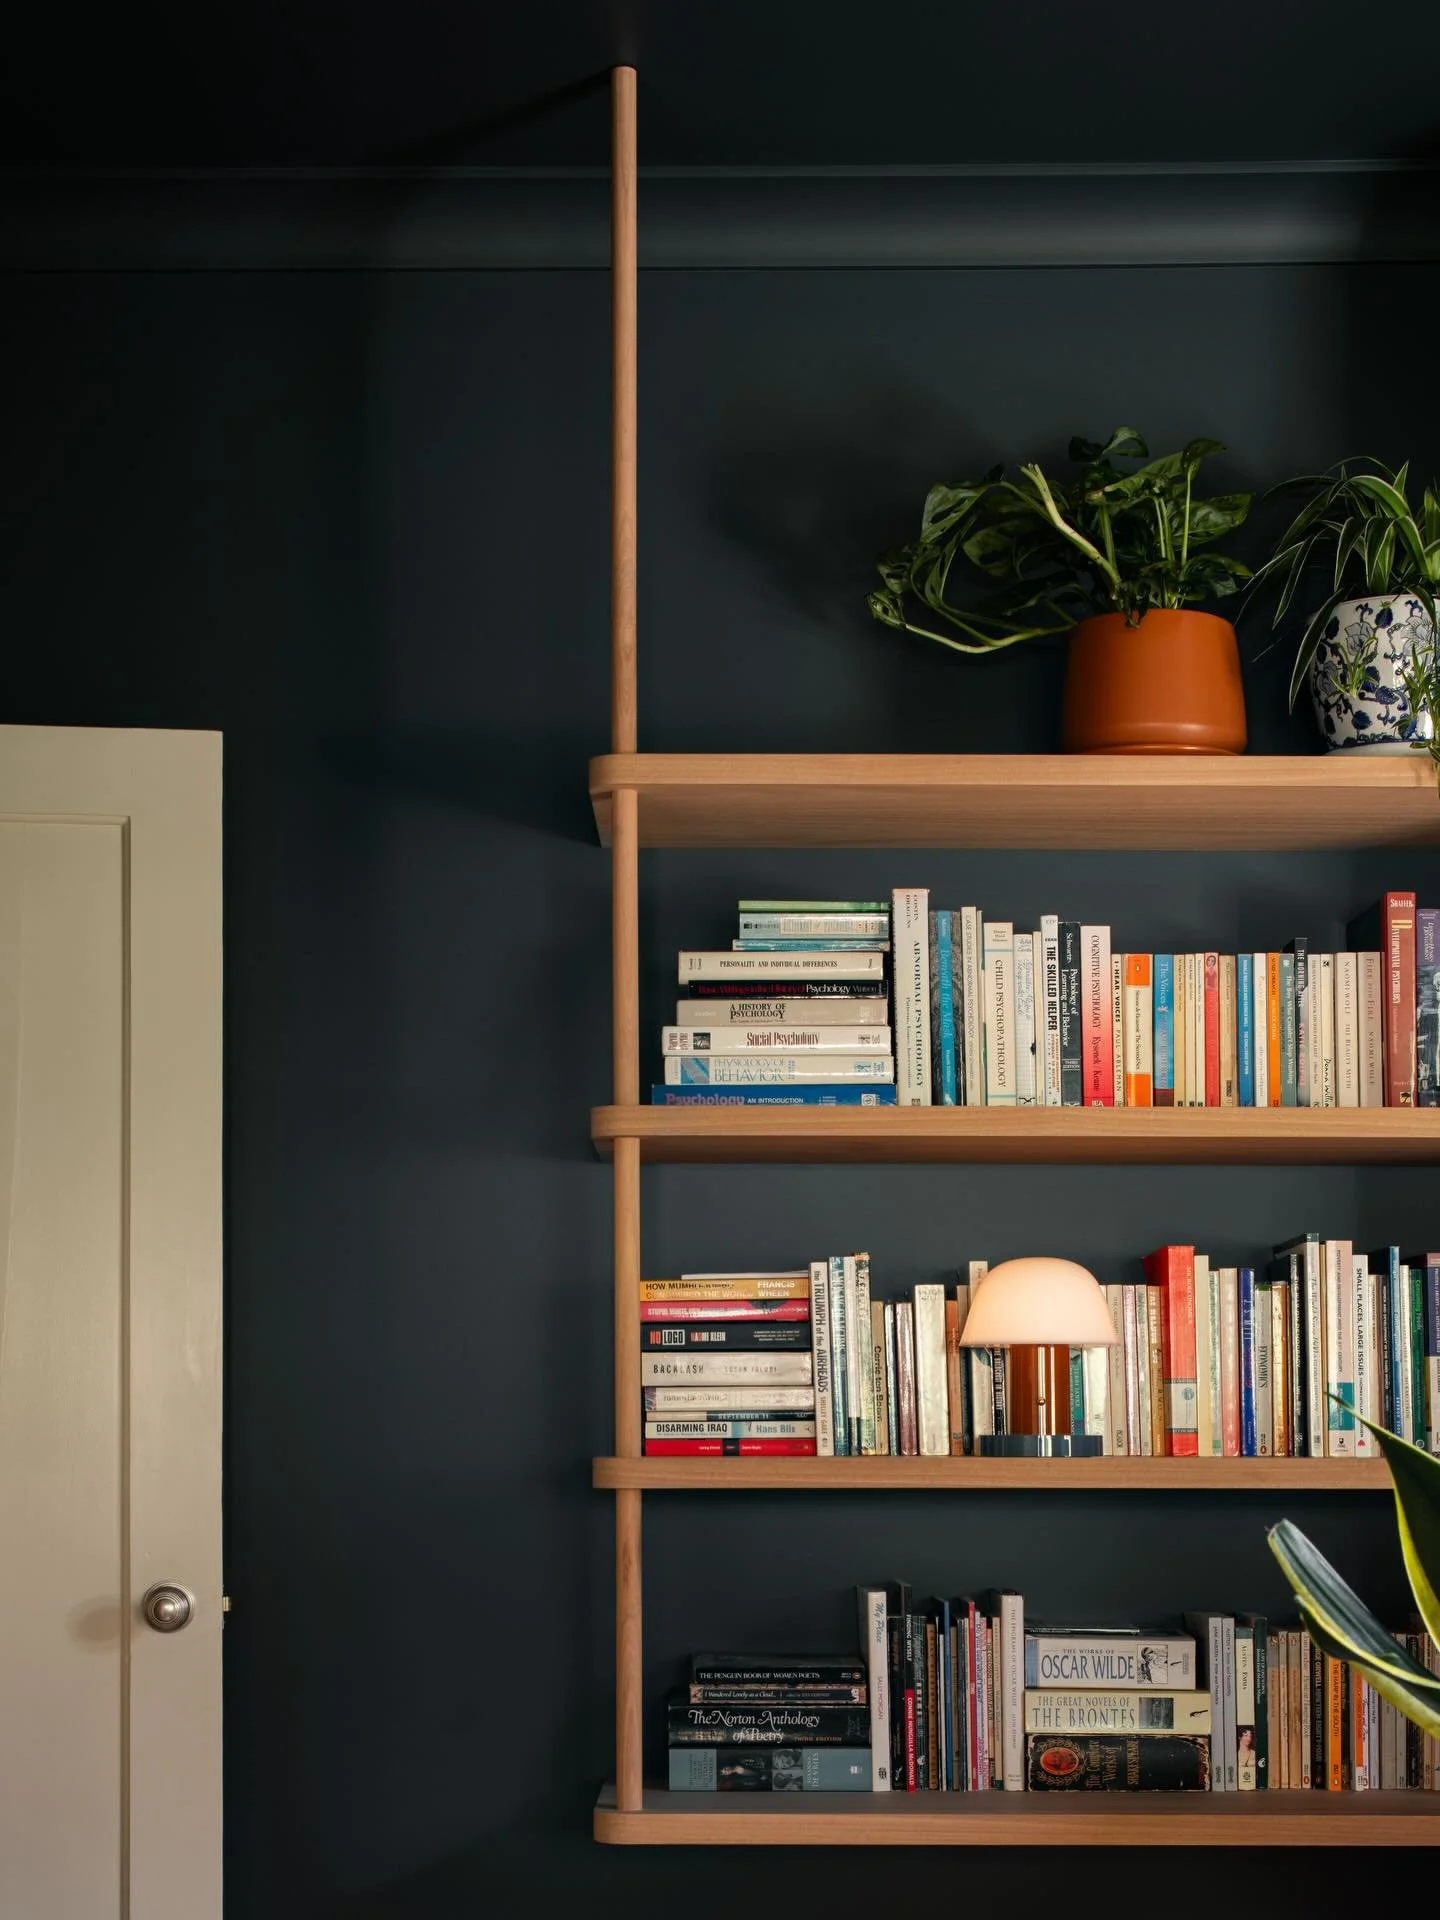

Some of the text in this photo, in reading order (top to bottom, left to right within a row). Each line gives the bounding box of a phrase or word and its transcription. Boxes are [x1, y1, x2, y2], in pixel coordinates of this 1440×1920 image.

[720, 960, 838, 968] PERSONALITY AND INDIVIDUAL DIFFERENCES
[1090, 935, 1102, 1029] COGNITIVE PSYCHOLOGY
[1160, 960, 1168, 1004] The Voices
[1297, 962, 1305, 988] MORNING
[806, 984, 851, 994] Psychology
[941, 950, 952, 1038] Beneath the Mask
[1046, 946, 1057, 1030] THE SKILLED HELPER
[1068, 968, 1080, 1015] Psychology of
[730, 1010, 785, 1020] PSYCHOLOGY
[913, 941, 923, 1088] ABNORMAL PSYCHOLOGY
[1060, 969, 1070, 1046] Learning and Behavior
[995, 960, 1006, 1088] CHILD PSYCHOPATHOLOGY
[747, 1032, 818, 1046] Social Psychology
[714, 1058, 784, 1066] PHYSIOLOGY OF
[1286, 1056, 1294, 1084] Washing
[1324, 1058, 1332, 1082] Donna
[714, 1069, 784, 1082] BEHAVIOR
[666, 1094, 744, 1105] Psychology
[814, 1271, 822, 1281] the
[758, 1290, 789, 1298] WHEEN
[814, 1283, 826, 1326] TRIUMPH
[1356, 1294, 1364, 1322] PLACES,
[650, 1331, 726, 1344] NO LOGO KLEIN
[816, 1336, 825, 1346] the
[654, 1365, 704, 1374] BACKLASH
[816, 1348, 828, 1392] AIRHEADS
[1259, 1346, 1268, 1388] ECONOMICS
[656, 1424, 704, 1432] DISARMING
[707, 1424, 728, 1432] IRAQ
[756, 1424, 777, 1432] Hans
[874, 1602, 884, 1617] My
[876, 1619, 884, 1643] Place
[1041, 1655, 1135, 1680] OSCAR WILDE
[1038, 1696, 1130, 1706] THE GREAT NOVELS OF
[688, 1709, 820, 1728] The Norton Anthology
[1032, 1708, 1136, 1728] THE BRONTES
[732, 1731, 744, 1744] of
[748, 1728, 784, 1744] Poetry
